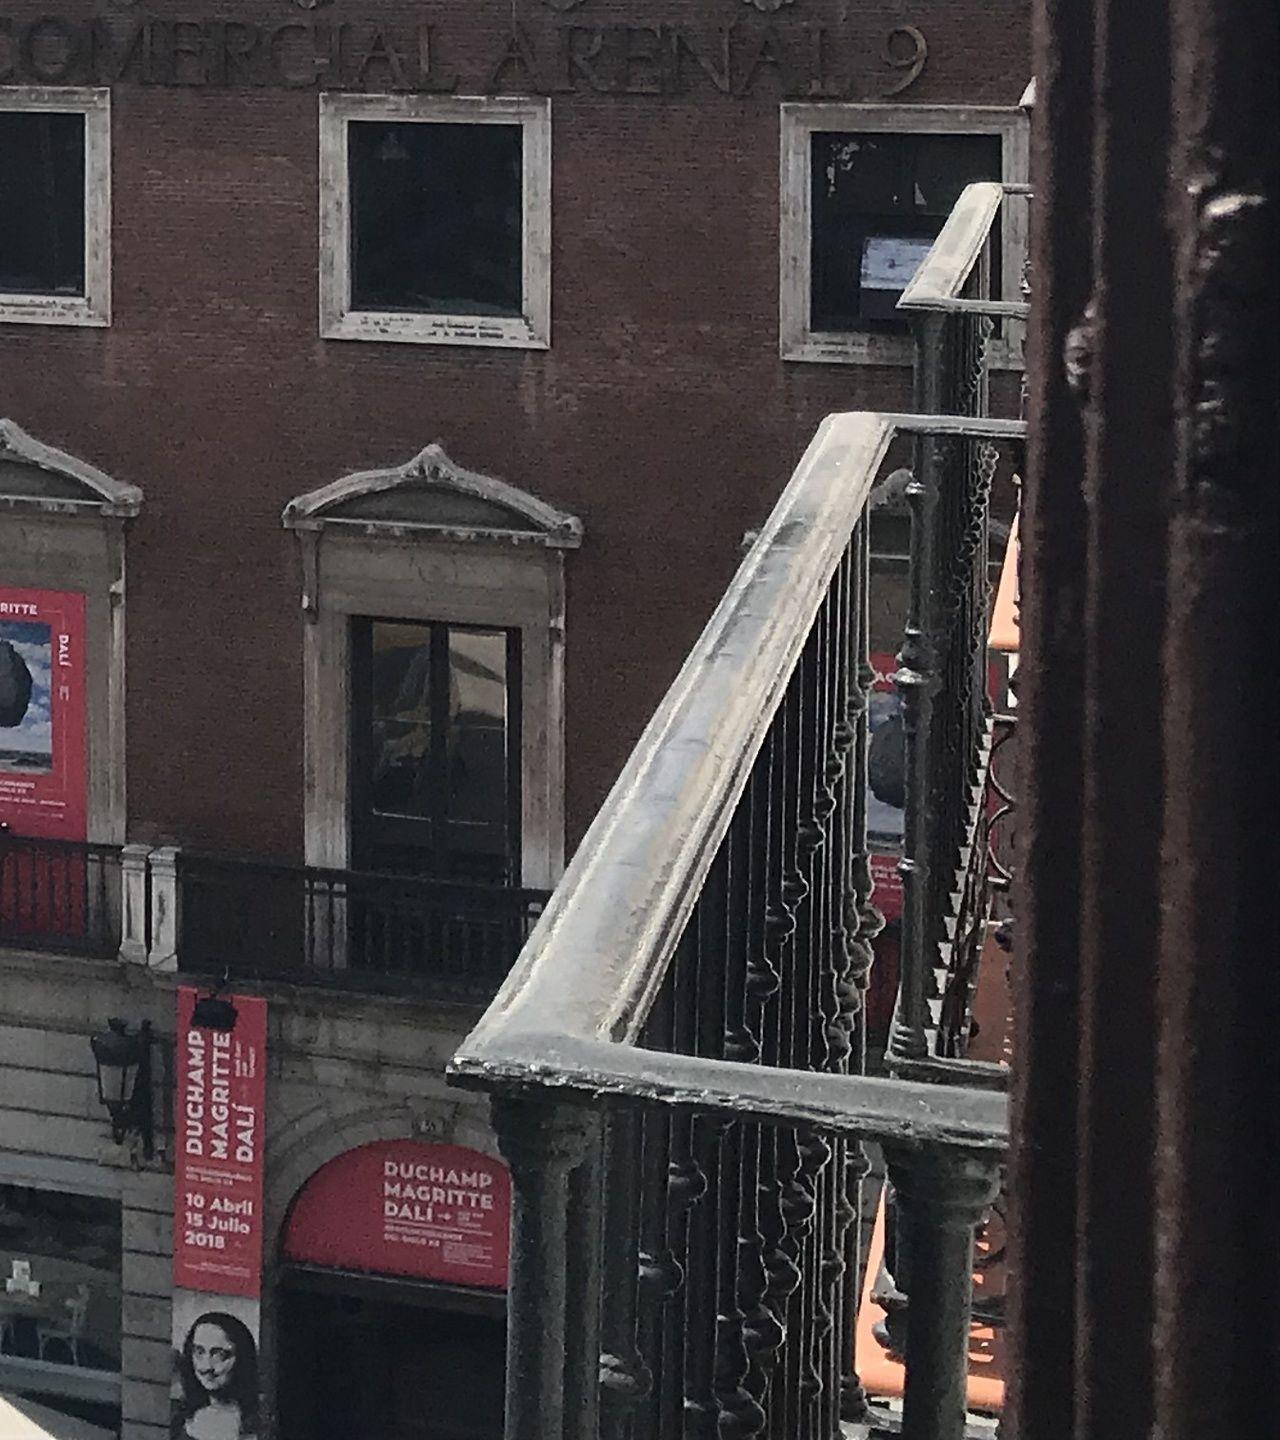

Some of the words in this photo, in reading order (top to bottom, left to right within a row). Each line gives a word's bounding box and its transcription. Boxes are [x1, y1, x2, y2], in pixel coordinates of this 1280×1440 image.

[487, 19, 850, 97] ARENAL
[879, 24, 929, 98] 9
[186, 1030, 206, 1156] DUCHAMP
[211, 1032, 230, 1160] MAGRITTE
[232, 1103, 255, 1163] DALÍ
[383, 1160, 493, 1189] DUCHAMP
[185, 1192, 206, 1209] 10
[209, 1198, 254, 1216] Abril
[383, 1181, 493, 1210] MAGRITTE
[185, 1211, 204, 1227] 15
[207, 1216, 252, 1234] Julio
[383, 1200, 434, 1222] DALÍ
[184, 1230, 226, 1250] 2018
